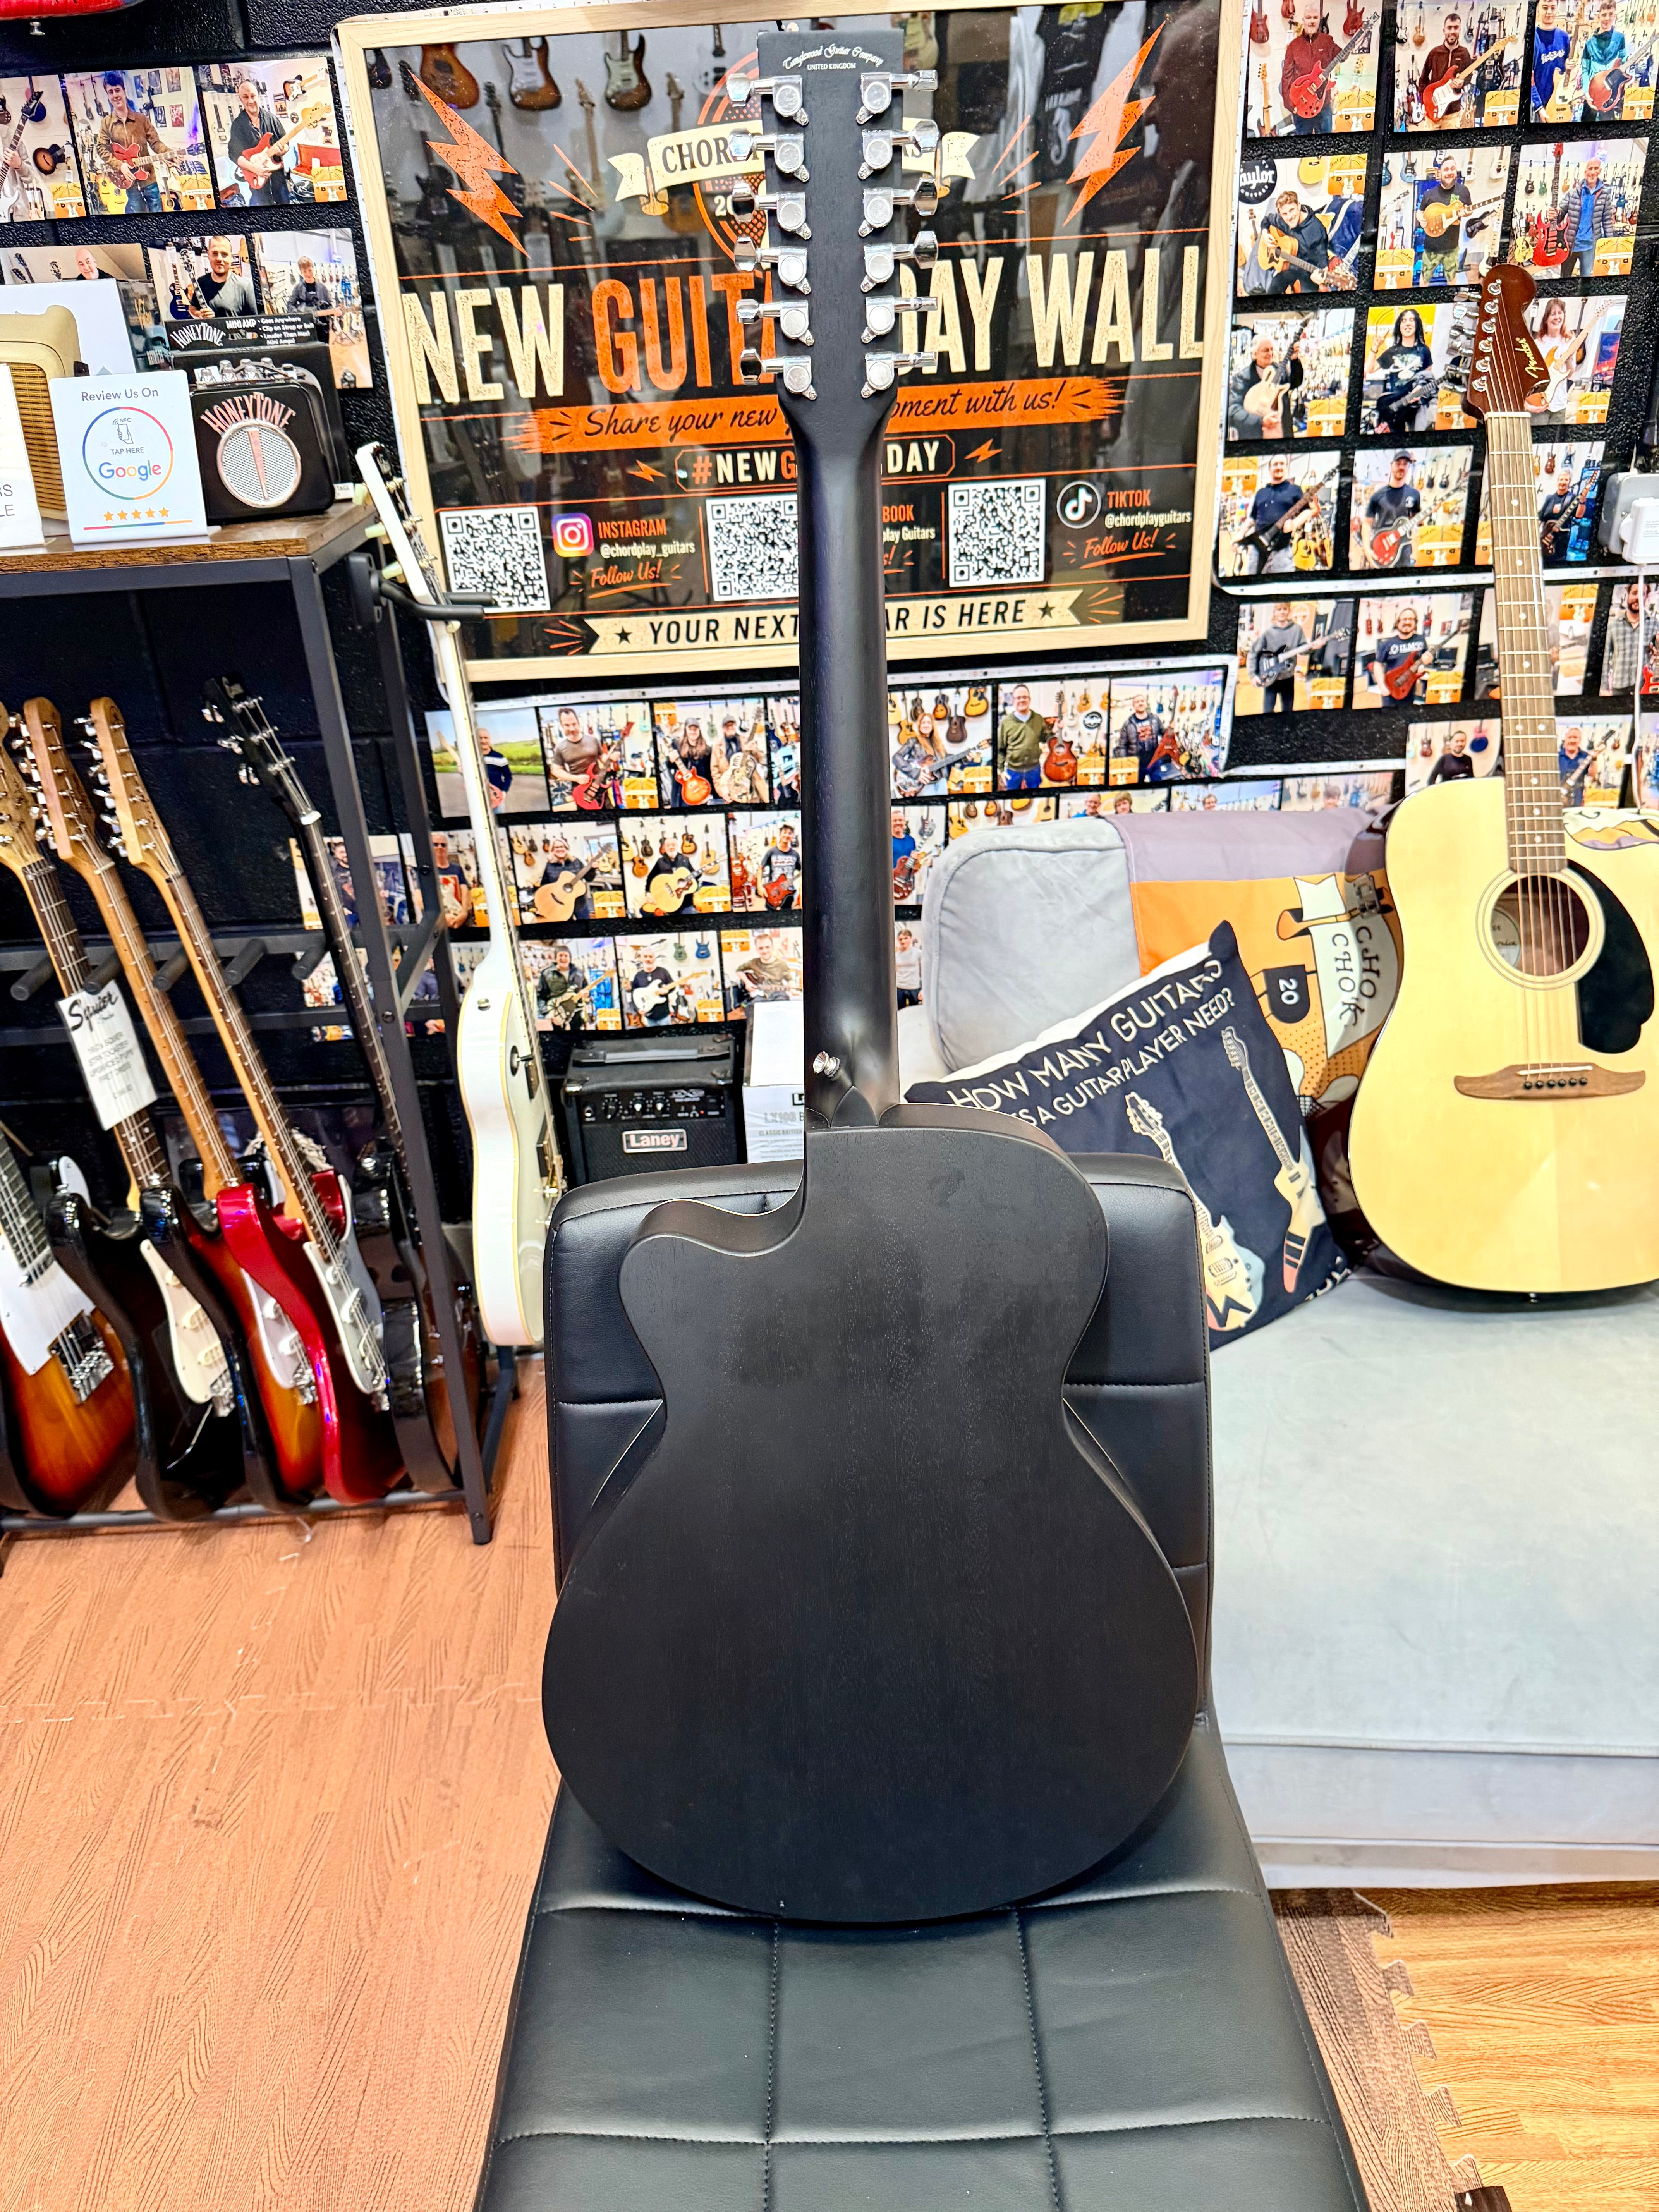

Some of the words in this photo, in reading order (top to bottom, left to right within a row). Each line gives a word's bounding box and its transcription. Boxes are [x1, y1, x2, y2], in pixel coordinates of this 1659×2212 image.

[783, 46, 823, 70] Tanglewood
[824, 43, 850, 58] Guitar
[852, 46, 884, 67] Company
[1240, 165, 1275, 189] aylor
[170, 322, 226, 349] HONEYTONE
[226, 320, 242, 329] MINI
[242, 319, 256, 328] AMP
[402, 283, 564, 404] NEW
[592, 271, 776, 394] GUIT
[1027, 246, 1204, 368] WALL
[1515, 338, 1544, 379] Fender
[81, 391, 121, 402] Review
[125, 389, 139, 398] Us
[141, 388, 158, 397] On
[200, 392, 296, 438] HONEYTONE
[585, 406, 661, 436] Share
[668, 411, 724, 443] your
[730, 408, 777, 427] new
[966, 382, 1017, 413] with
[1023, 380, 1067, 410] us!
[99, 460, 162, 481] Google
[1107, 489, 1151, 508] TIKTOK
[882, 504, 915, 523] BOOK
[1105, 509, 1192, 528] @chordplayguitars
[598, 519, 667, 539] INSTAGRAM
[902, 525, 936, 541] Guitars
[600, 540, 696, 558] @chordplay_guitars
[1084, 535, 1129, 559] Follow
[1132, 528, 1159, 551] Us!
[591, 565, 634, 589] Follow
[637, 559, 662, 580] Us!
[649, 619, 720, 645] YOUR
[923, 605, 946, 629] IS
[958, 599, 1026, 627] HERE
[1279, 977, 1300, 1005] 20
[68, 991, 118, 1032] Squier
[1037, 1105, 1056, 1125] A
[1182, 987, 1235, 1036] NEED?
[946, 1070, 1030, 1110] HOW
[1029, 1031, 1112, 1087] MANY
[629, 1133, 680, 1147] Laney
